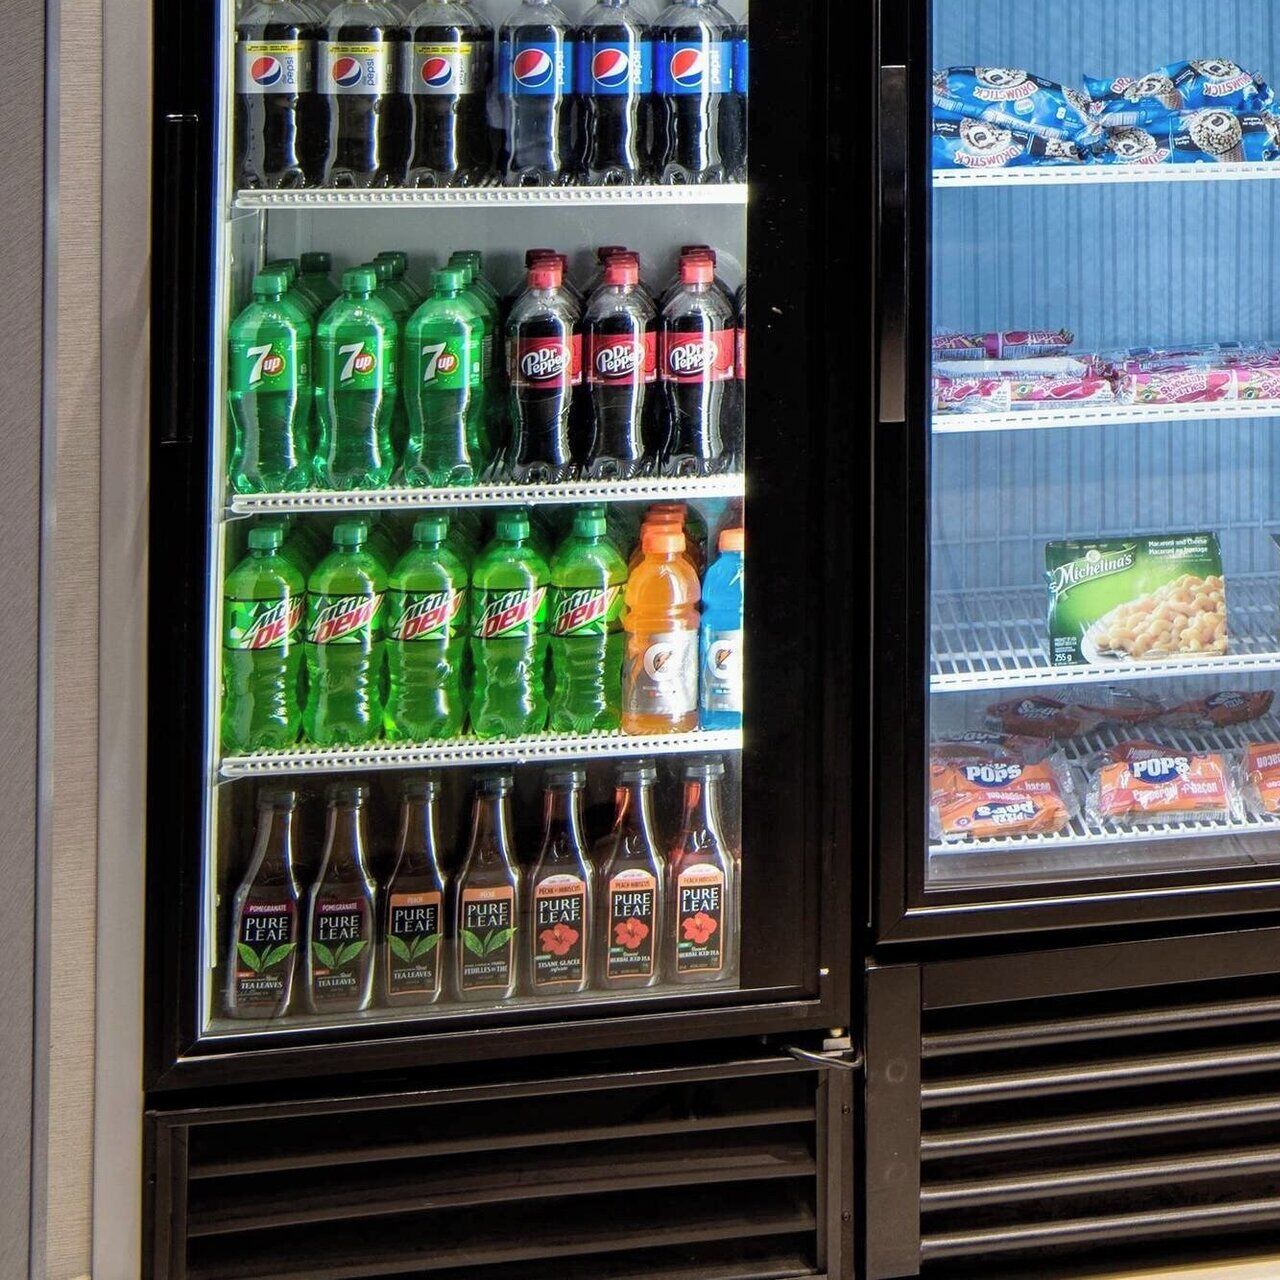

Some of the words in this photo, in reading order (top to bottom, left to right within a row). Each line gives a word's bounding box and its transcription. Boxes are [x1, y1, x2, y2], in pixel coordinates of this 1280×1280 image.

[285, 56, 295, 85] pepsi
[367, 58, 375, 86] pepsi
[633, 50, 643, 84] pepsi
[709, 50, 721, 85] pepsi
[973, 81, 1037, 101] DRUMSTICK
[1204, 72, 1252, 97] UMSTICK
[953, 145, 1024, 168] DRUMSTICK
[543, 345, 558, 361] Dr
[614, 344, 632, 360] Dr
[687, 342, 703, 360] Dr
[1054, 552, 1135, 592] Michelina's
[966, 765, 1022, 782] POPS
[1133, 757, 1190, 778] POPS
[615, 893, 650, 905] PURE
[683, 887, 719, 900] PURE
[468, 902, 508, 916] PURE
[540, 898, 580, 912] PURE
[615, 904, 650, 916] LEAF
[682, 900, 719, 912] LEAF
[395, 908, 434, 920] PURE
[467, 914, 508, 928] LEAF
[540, 909, 580, 924] LEAF
[246, 917, 288, 929] PURE
[320, 916, 359, 928] PURE
[395, 920, 434, 933] LEAF
[245, 930, 288, 941] LEAF
[320, 928, 359, 940] LEAF
